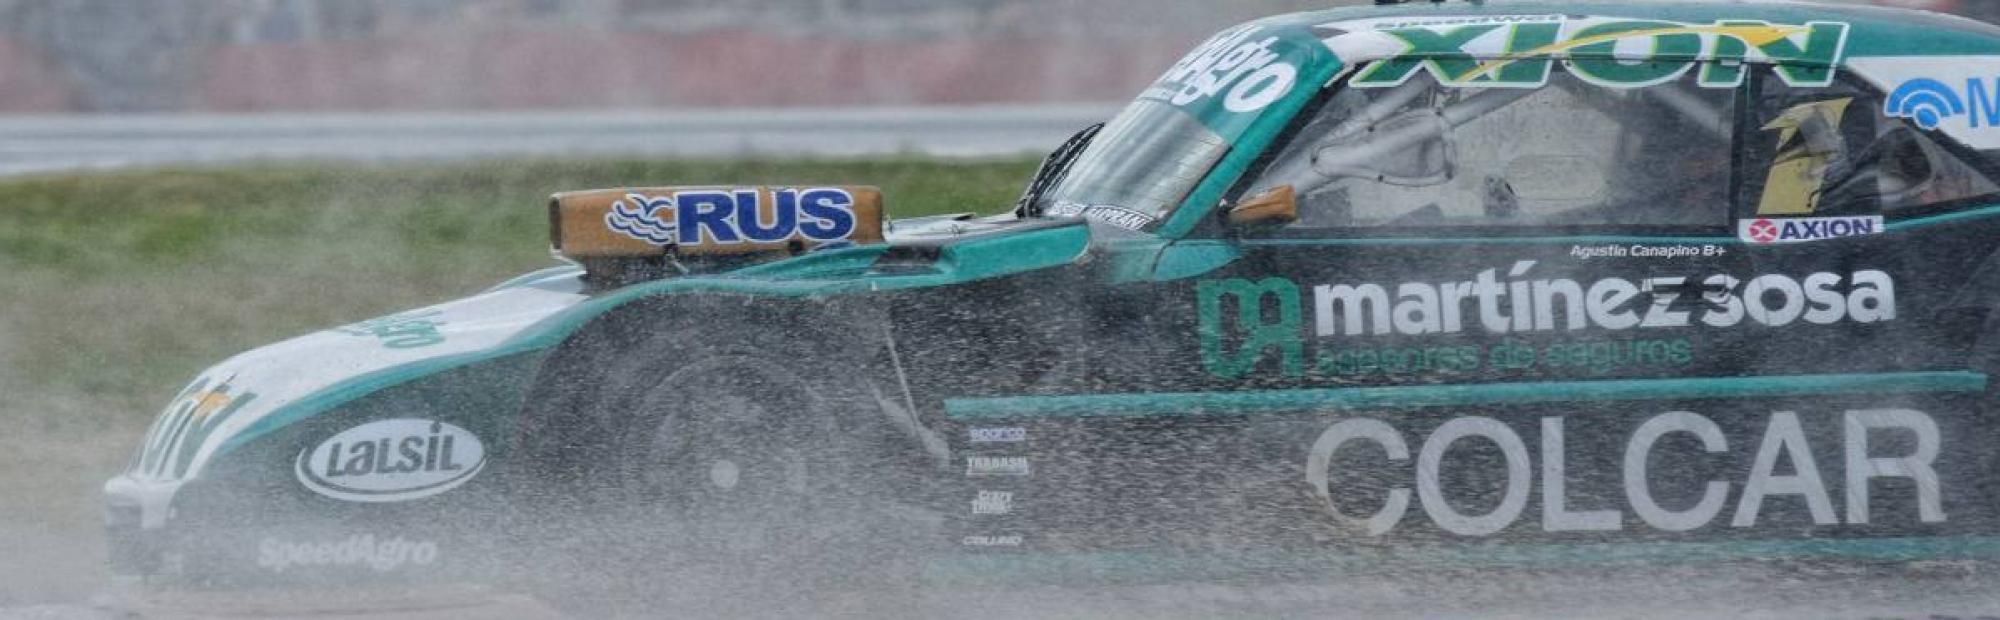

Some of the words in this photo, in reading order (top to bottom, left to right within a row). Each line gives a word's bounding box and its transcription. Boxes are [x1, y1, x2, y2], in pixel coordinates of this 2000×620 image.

[674, 188, 855, 244] RUS
[1780, 219, 1874, 241] AXION
[1631, 245, 1700, 258] Canapino
[1703, 245, 1726, 256] B+
[1314, 261, 1693, 336] martínez
[1701, 269, 1897, 327] sosa
[1489, 340, 1536, 369] de
[1545, 337, 1692, 370] seguros
[1305, 409, 1946, 536] COLCAR
[258, 534, 437, 570] SpeedAgro
